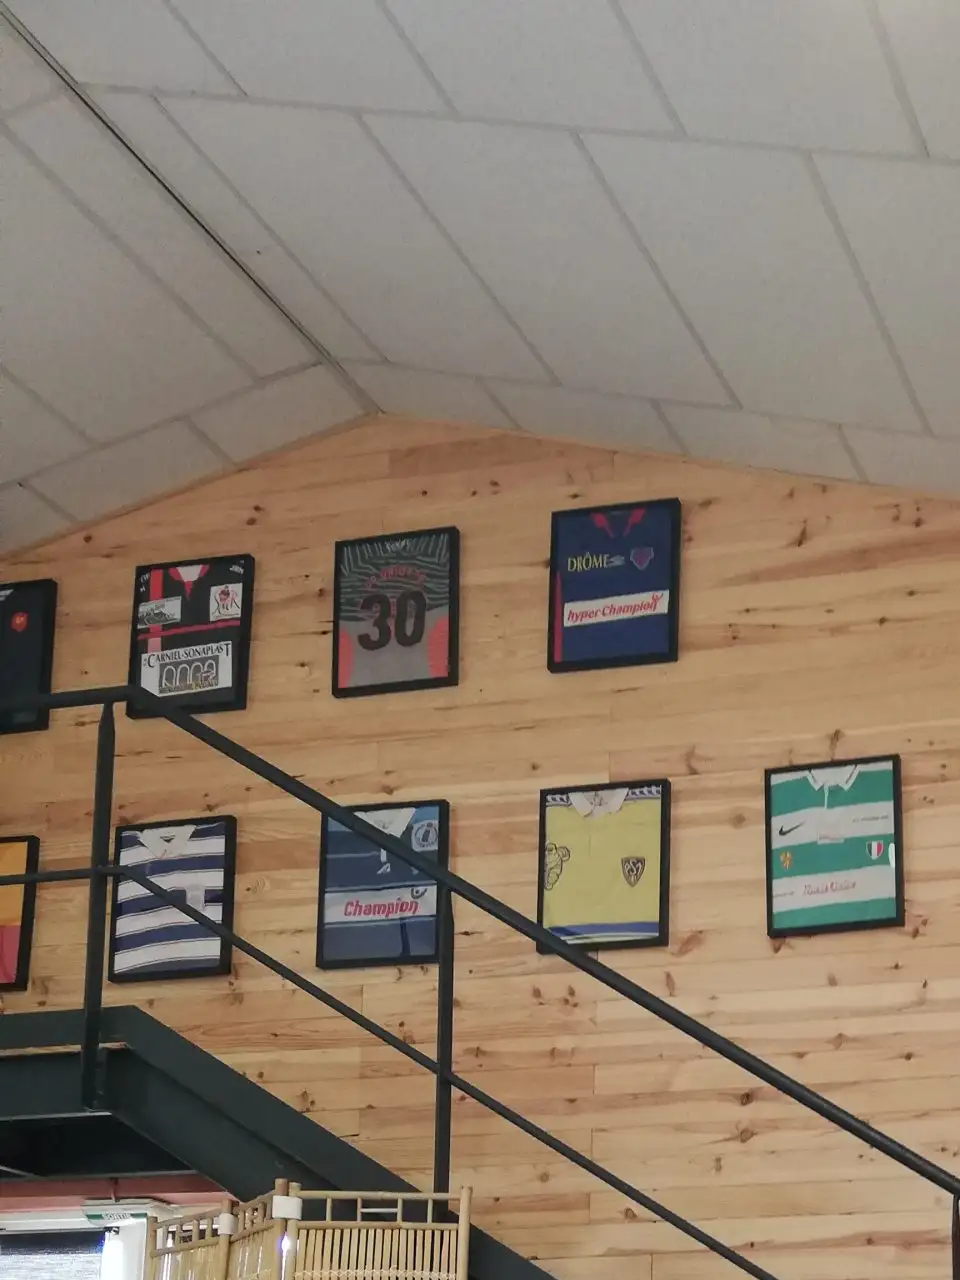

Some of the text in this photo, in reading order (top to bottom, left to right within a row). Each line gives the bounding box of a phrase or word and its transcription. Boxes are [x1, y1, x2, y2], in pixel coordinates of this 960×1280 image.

[567, 552, 610, 572] DRÔME
[602, 600, 659, 619] Champion
[358, 590, 427, 651] 30
[343, 897, 419, 918] Champion
